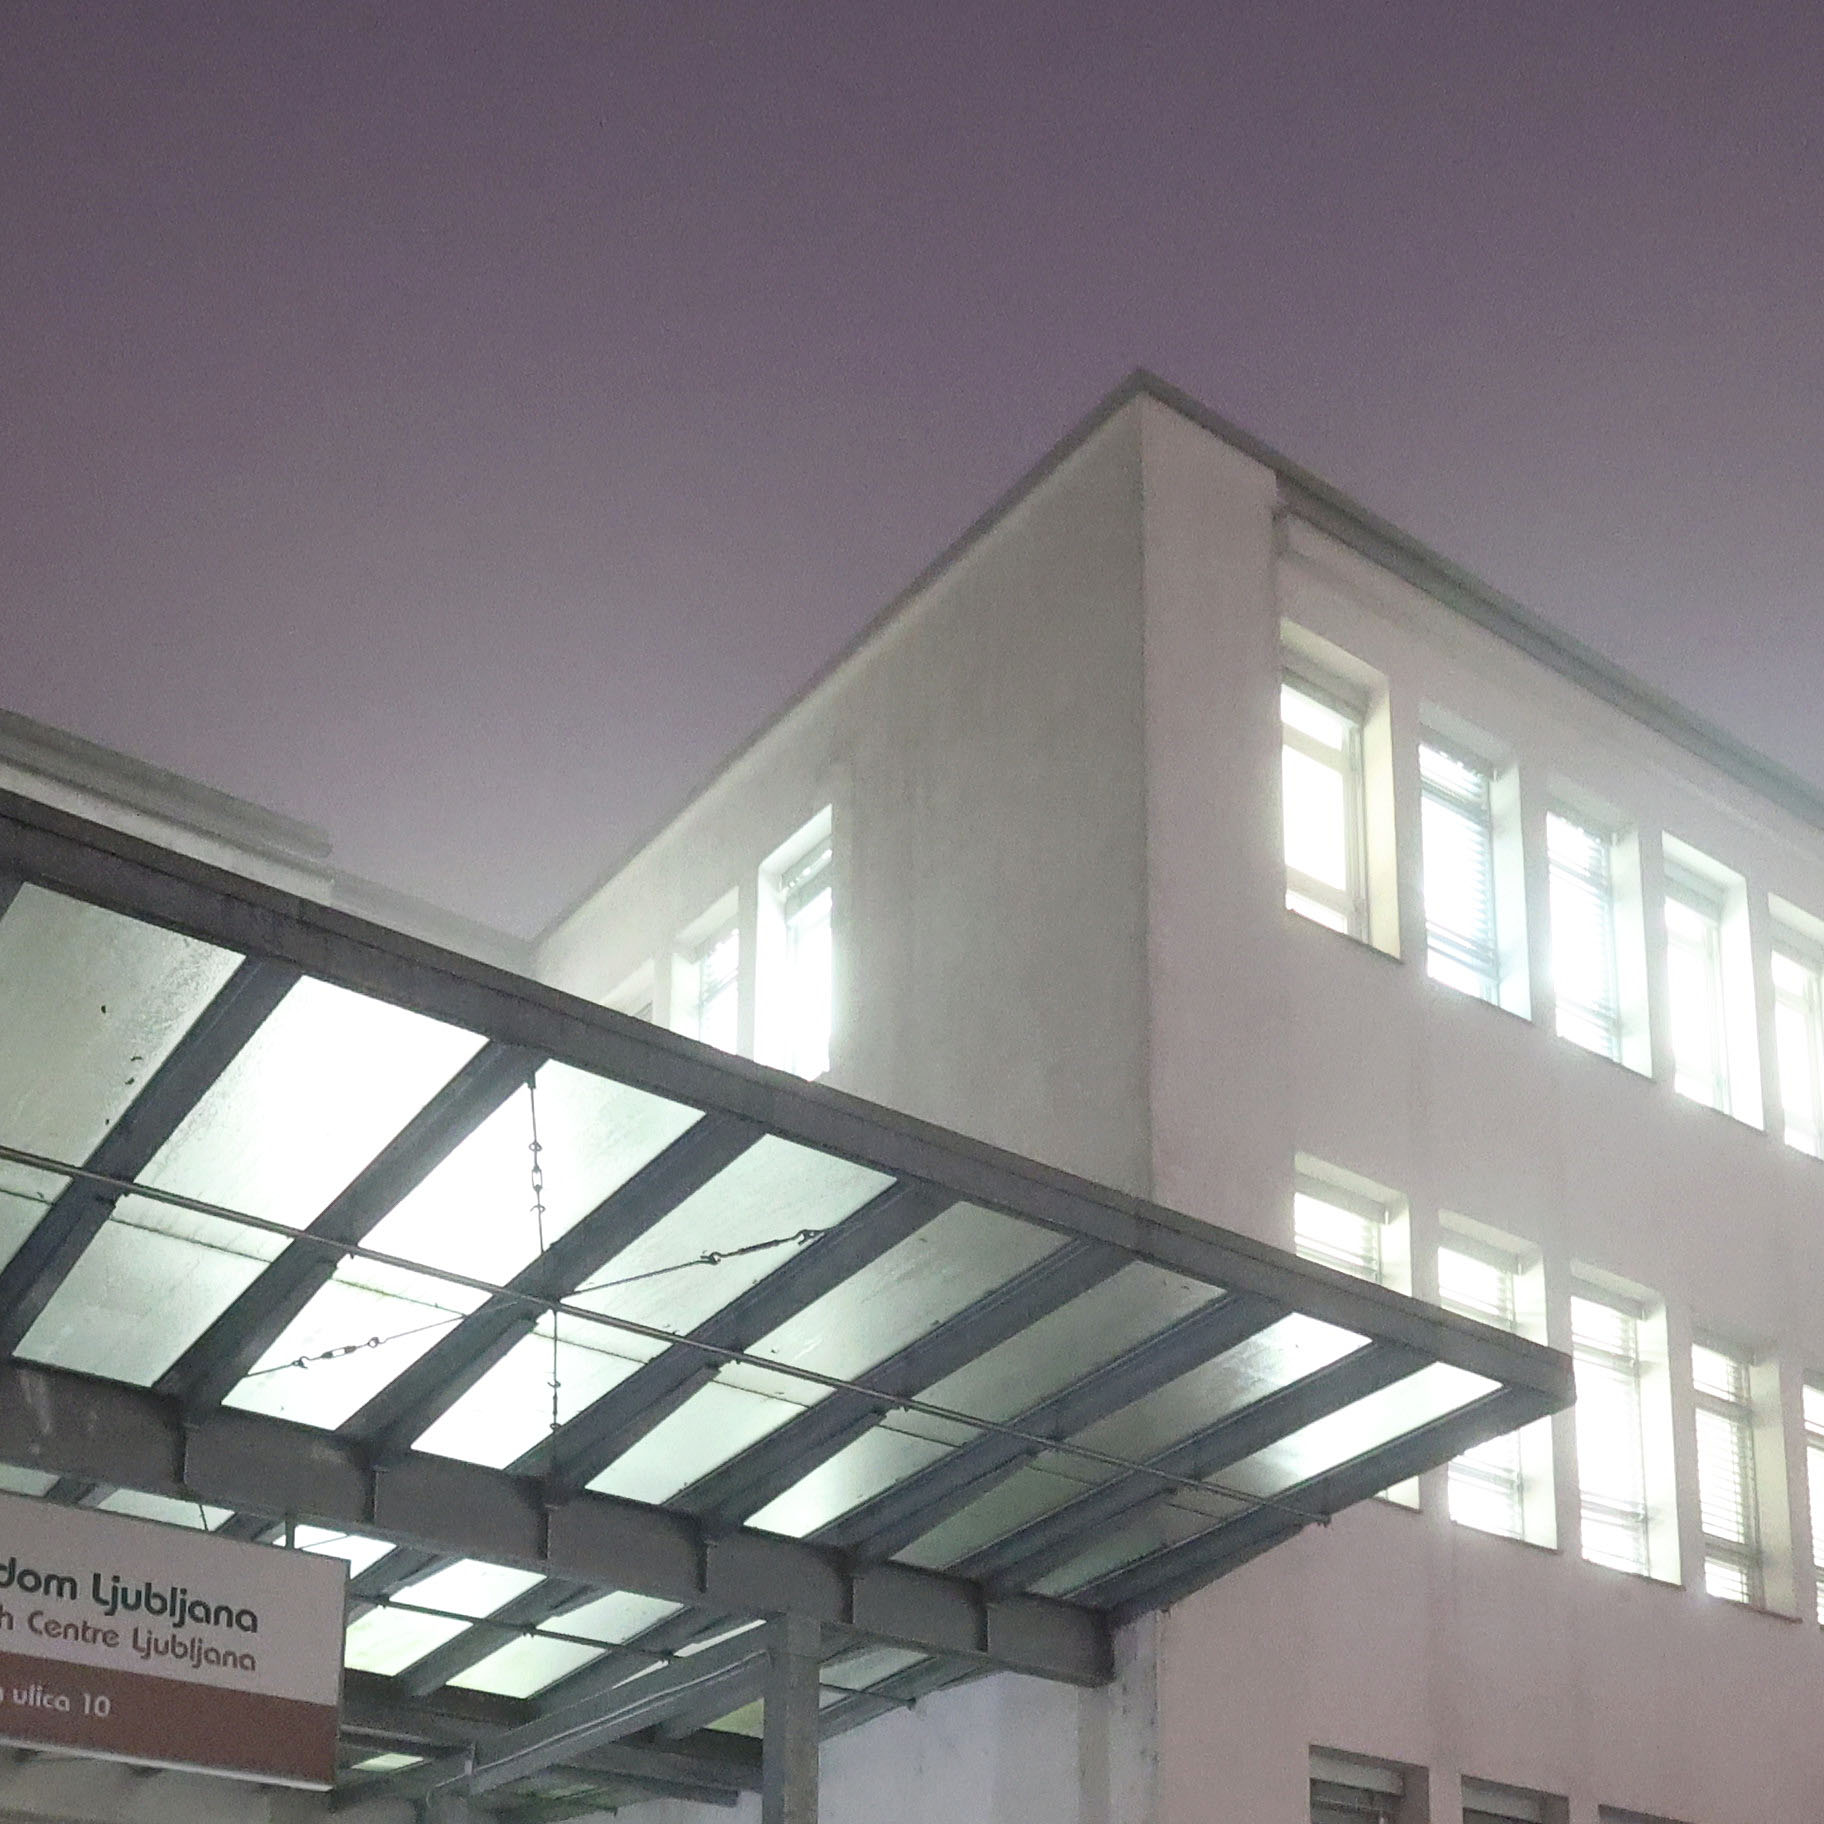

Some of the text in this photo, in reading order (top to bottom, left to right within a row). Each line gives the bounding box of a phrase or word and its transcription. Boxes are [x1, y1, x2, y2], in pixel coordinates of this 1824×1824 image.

[92, 1573, 258, 1633] Ljubljana
[27, 1610, 120, 1648] Centre
[132, 1627, 257, 1671] Ljubljana
[12, 1683, 71, 1713] ulica
[83, 1692, 111, 1718] 10
